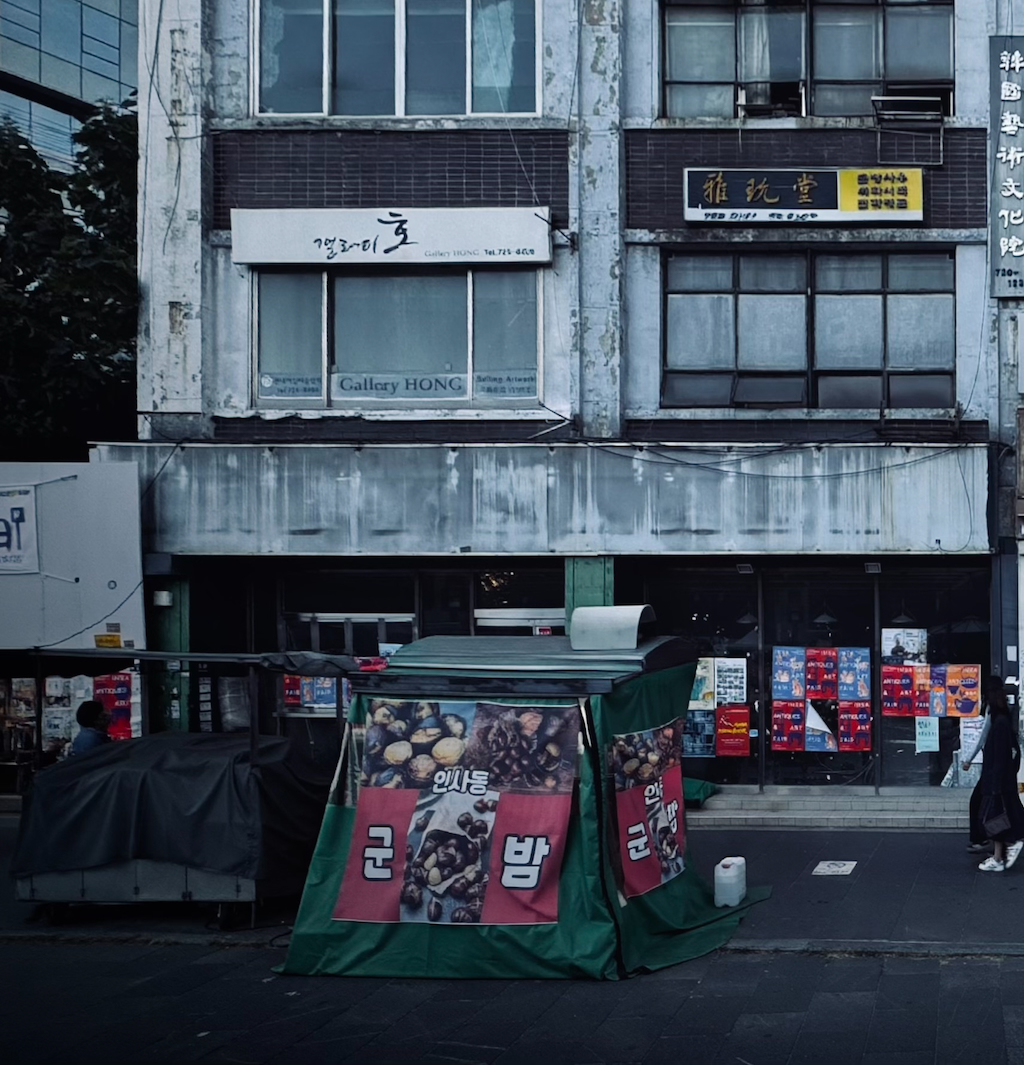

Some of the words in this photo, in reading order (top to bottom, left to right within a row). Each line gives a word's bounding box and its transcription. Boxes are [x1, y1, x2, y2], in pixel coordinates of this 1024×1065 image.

[340, 376, 398, 395] Gallery
[405, 377, 463, 392] HONG
[432, 767, 490, 796] 인사동
[362, 824, 394, 881] 군
[500, 834, 551, 890] 밤
